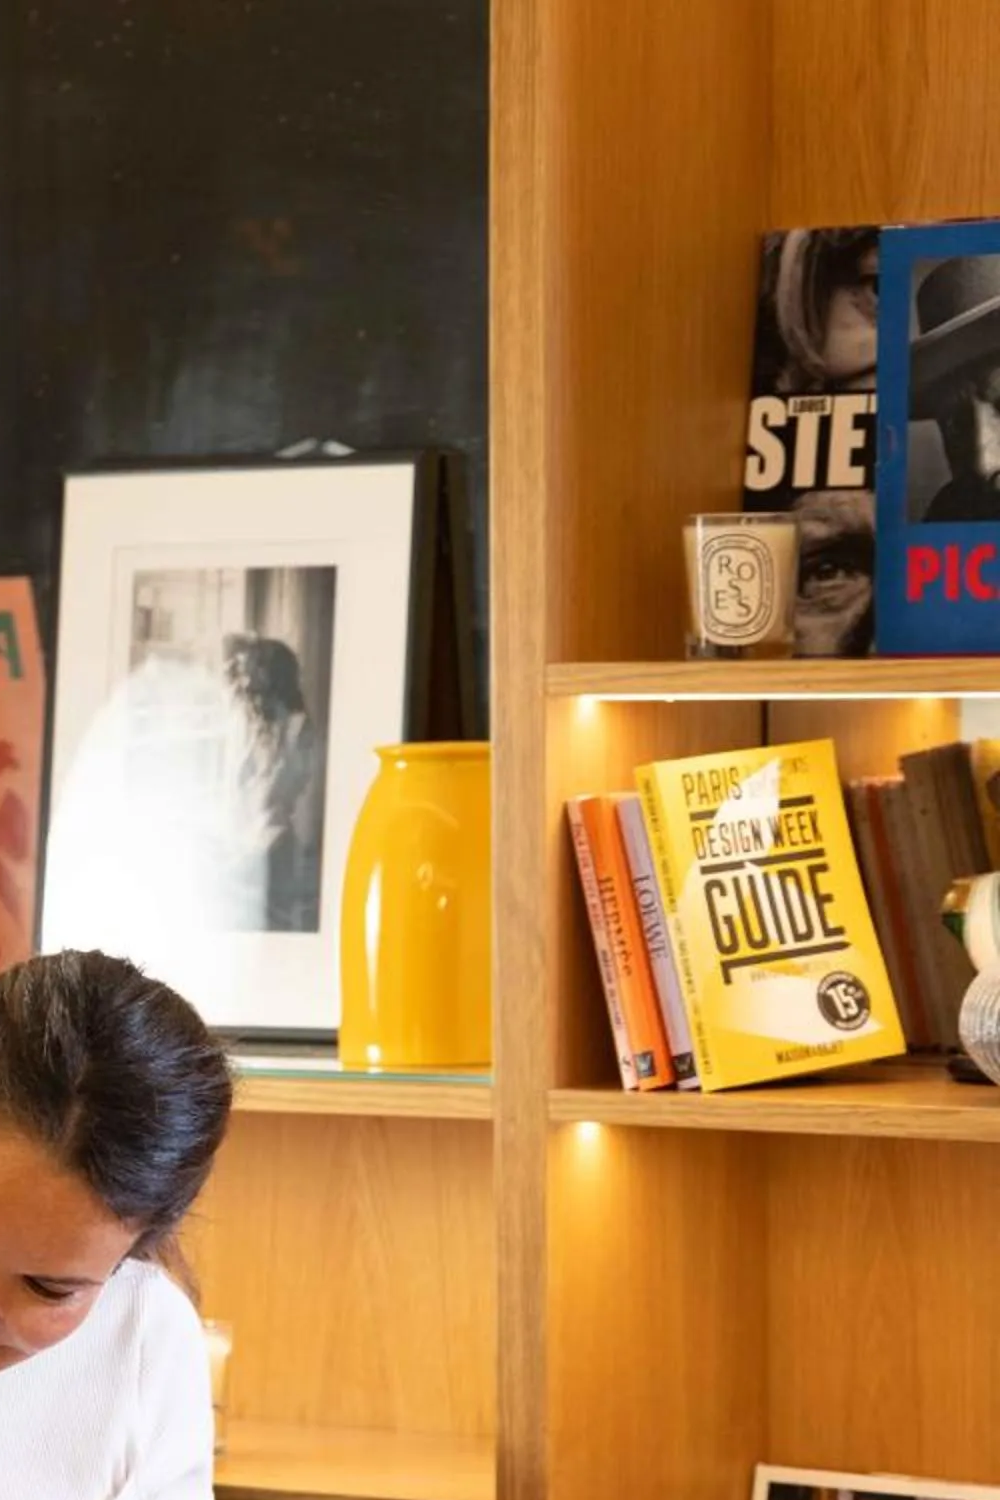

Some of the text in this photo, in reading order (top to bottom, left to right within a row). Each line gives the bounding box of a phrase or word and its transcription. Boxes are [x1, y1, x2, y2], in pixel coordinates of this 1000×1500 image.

[744, 394, 877, 491] STE
[907, 543, 1000, 603] PIC
[681, 765, 744, 807] PARIS
[691, 808, 824, 861] DESIGN WEEK
[633, 874, 669, 959] LOEWE
[704, 863, 846, 956] GUIDE
